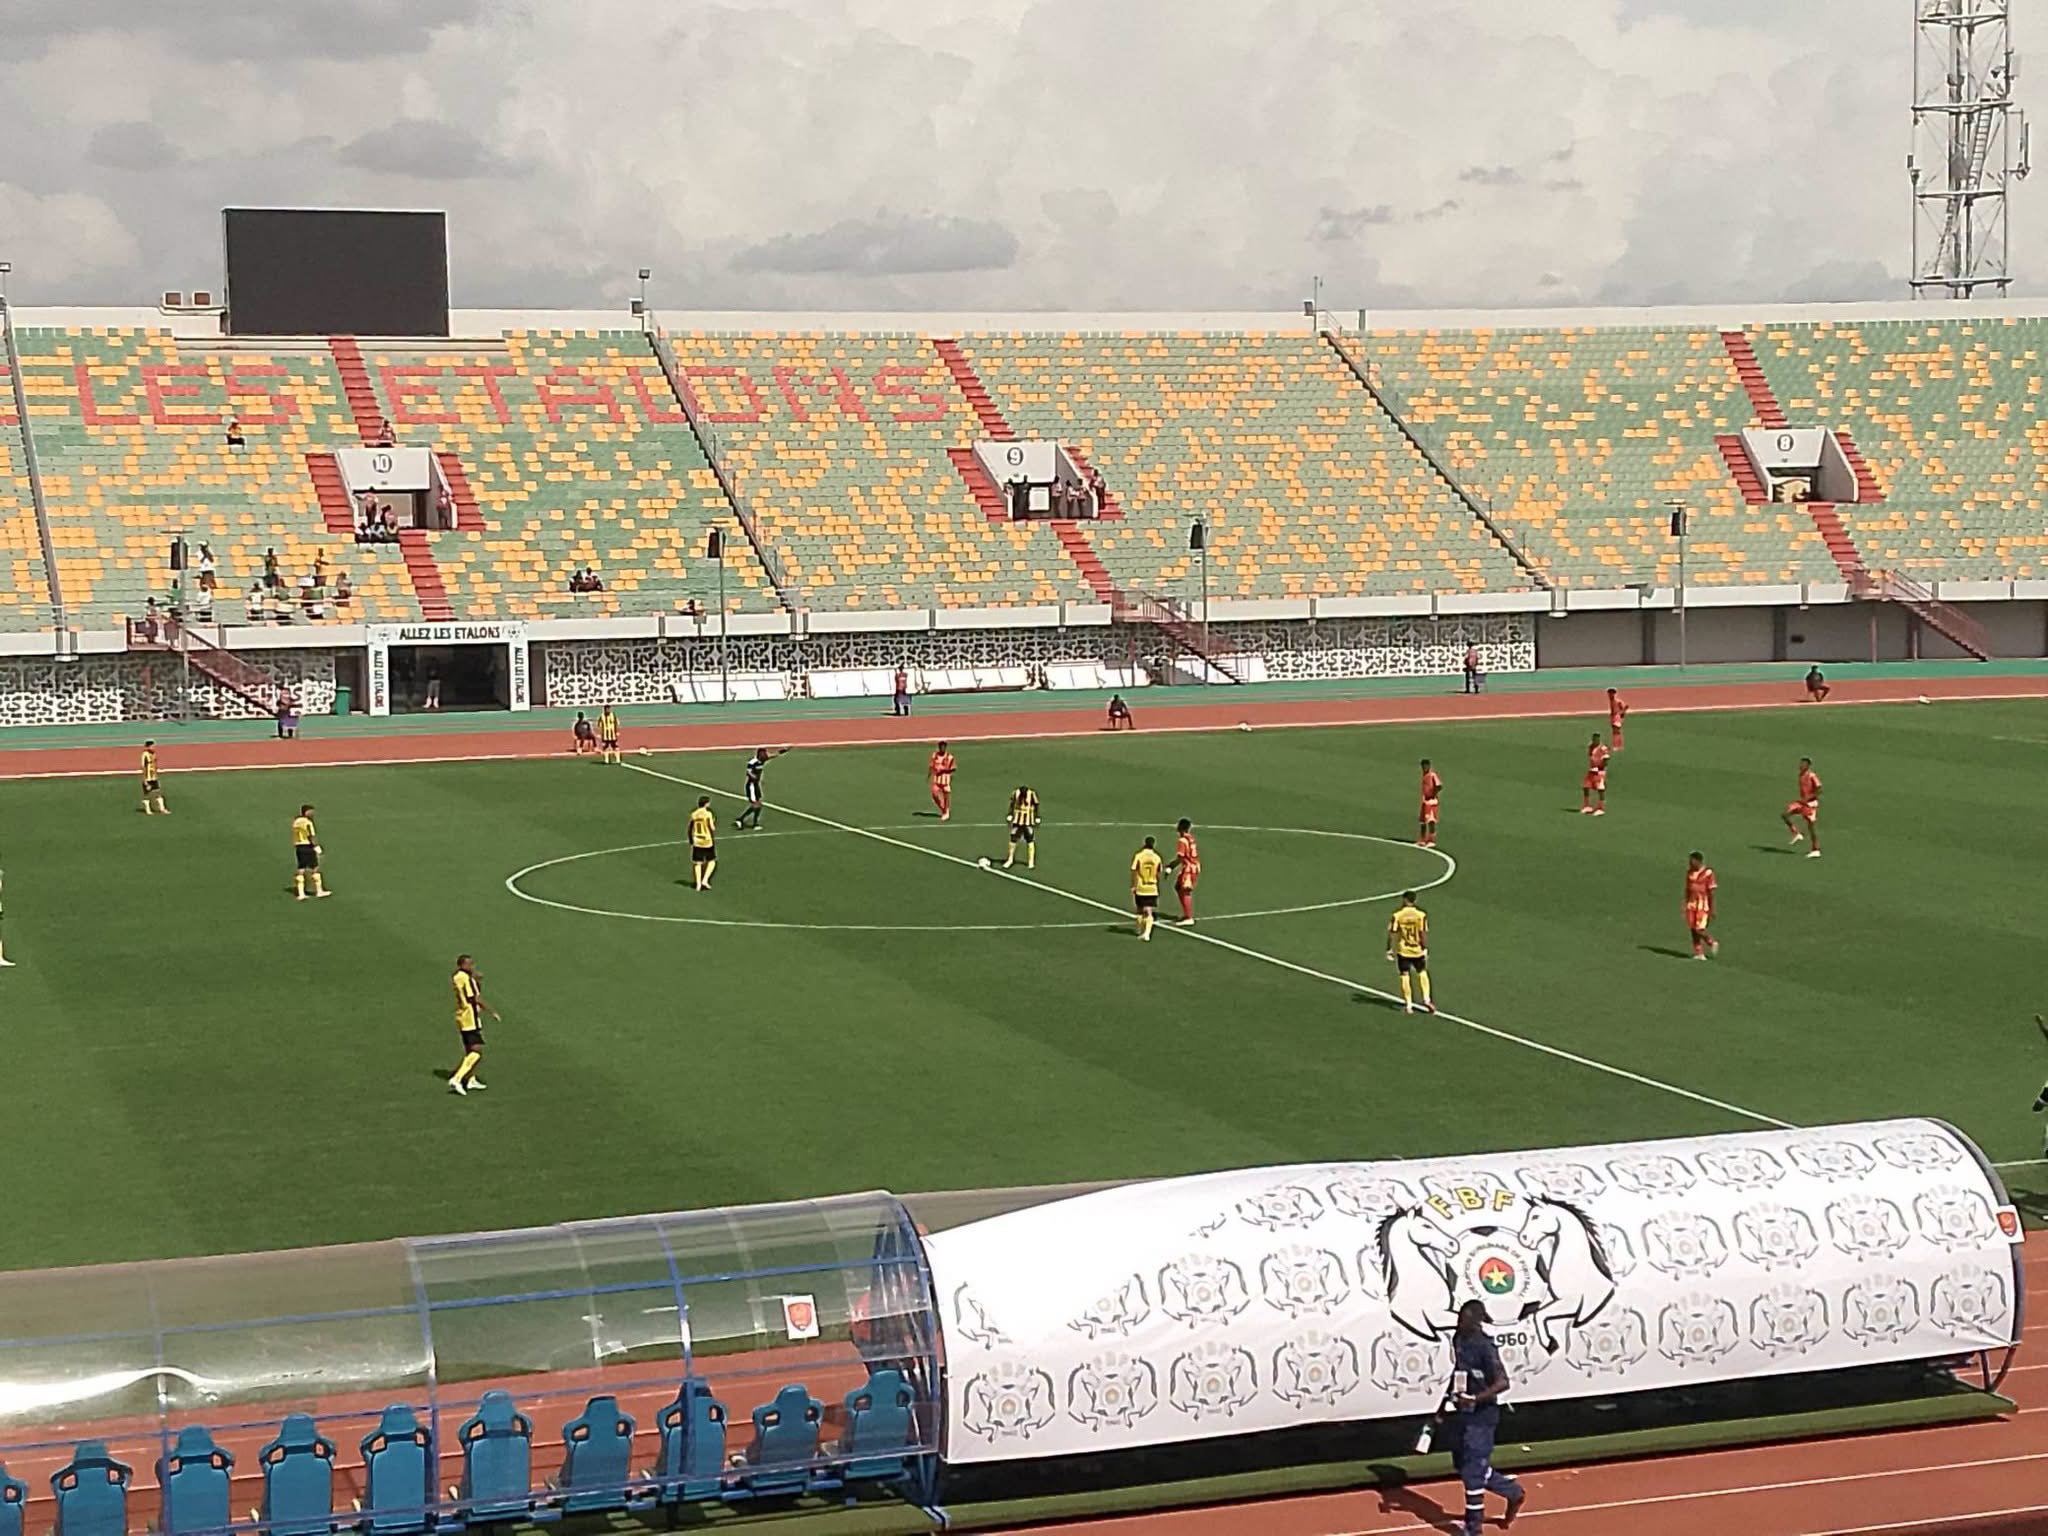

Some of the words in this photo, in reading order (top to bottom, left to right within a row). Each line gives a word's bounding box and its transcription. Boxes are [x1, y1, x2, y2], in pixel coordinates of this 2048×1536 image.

[73, 365, 300, 426] LES
[375, 454, 391, 472] 10
[1008, 448, 1022, 466] 9
[399, 627, 431, 640] ALLEZ
[433, 627, 451, 640] LES
[454, 626, 500, 639] ETALONS
[1425, 1186, 1516, 1220] FBF
[1496, 1332, 1528, 1348] 960
